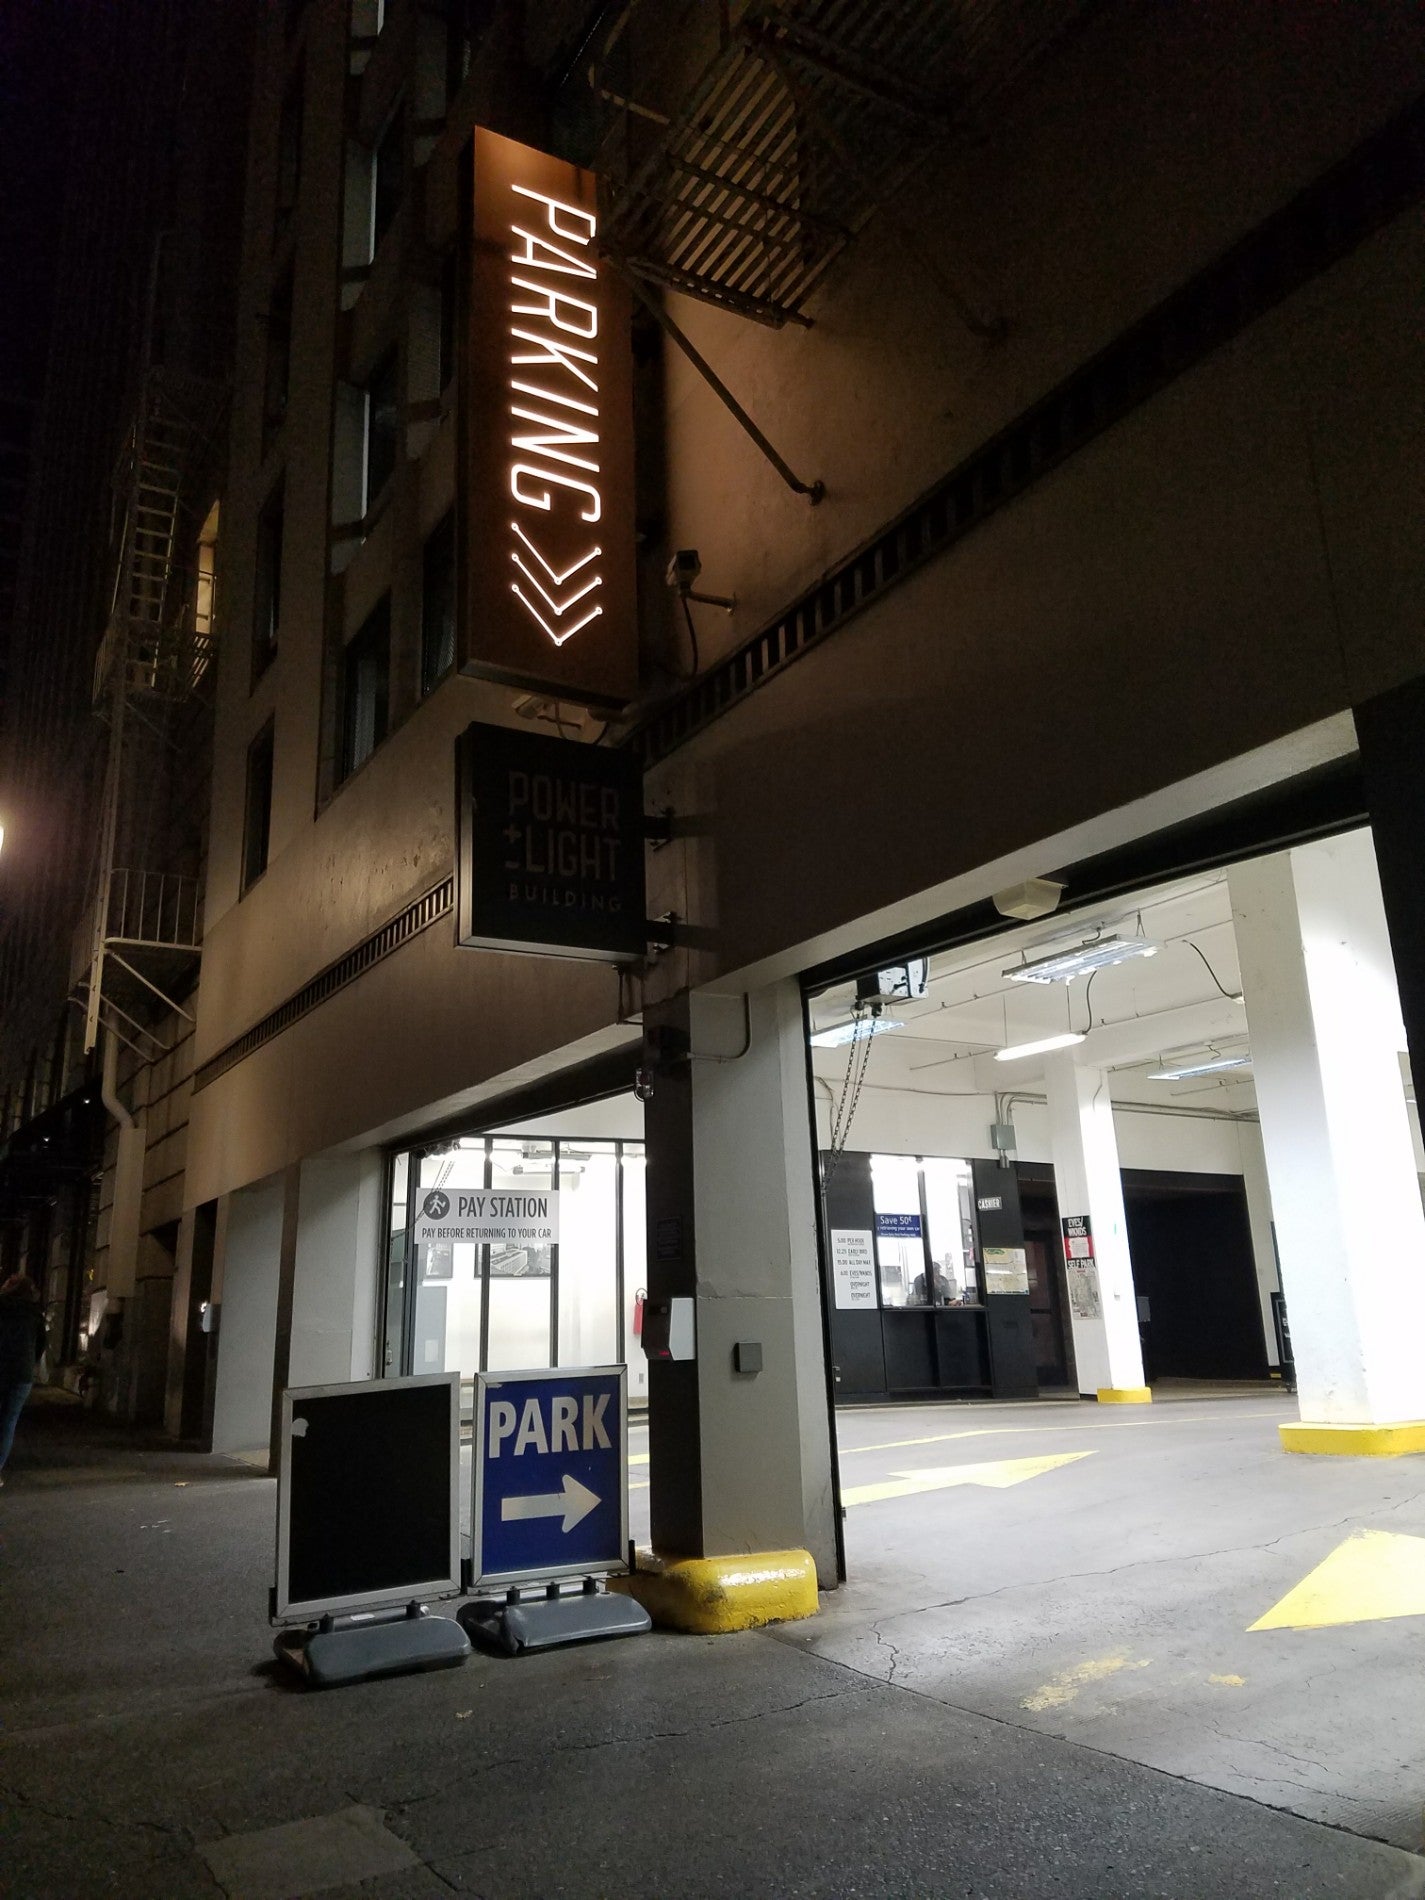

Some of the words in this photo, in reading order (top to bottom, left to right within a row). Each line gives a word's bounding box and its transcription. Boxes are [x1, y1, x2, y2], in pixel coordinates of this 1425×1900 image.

[511, 184, 601, 523] PARKING
[508, 770, 620, 833] POWER
[525, 824, 622, 881] LIGHT
[508, 880, 622, 912] BUILDING
[458, 1197, 486, 1217] PAY
[489, 1197, 548, 1218] STATION
[978, 1198, 1000, 1209] CASHIER
[422, 1228, 436, 1238] PAY
[437, 1228, 464, 1239] BEFORE
[466, 1228, 506, 1239] RETURNING
[507, 1228, 516, 1238] TO
[518, 1228, 536, 1239] YOUR
[538, 1229, 552, 1239] CAR
[880, 1215, 898, 1225] Save
[488, 1394, 612, 1459] PARK
